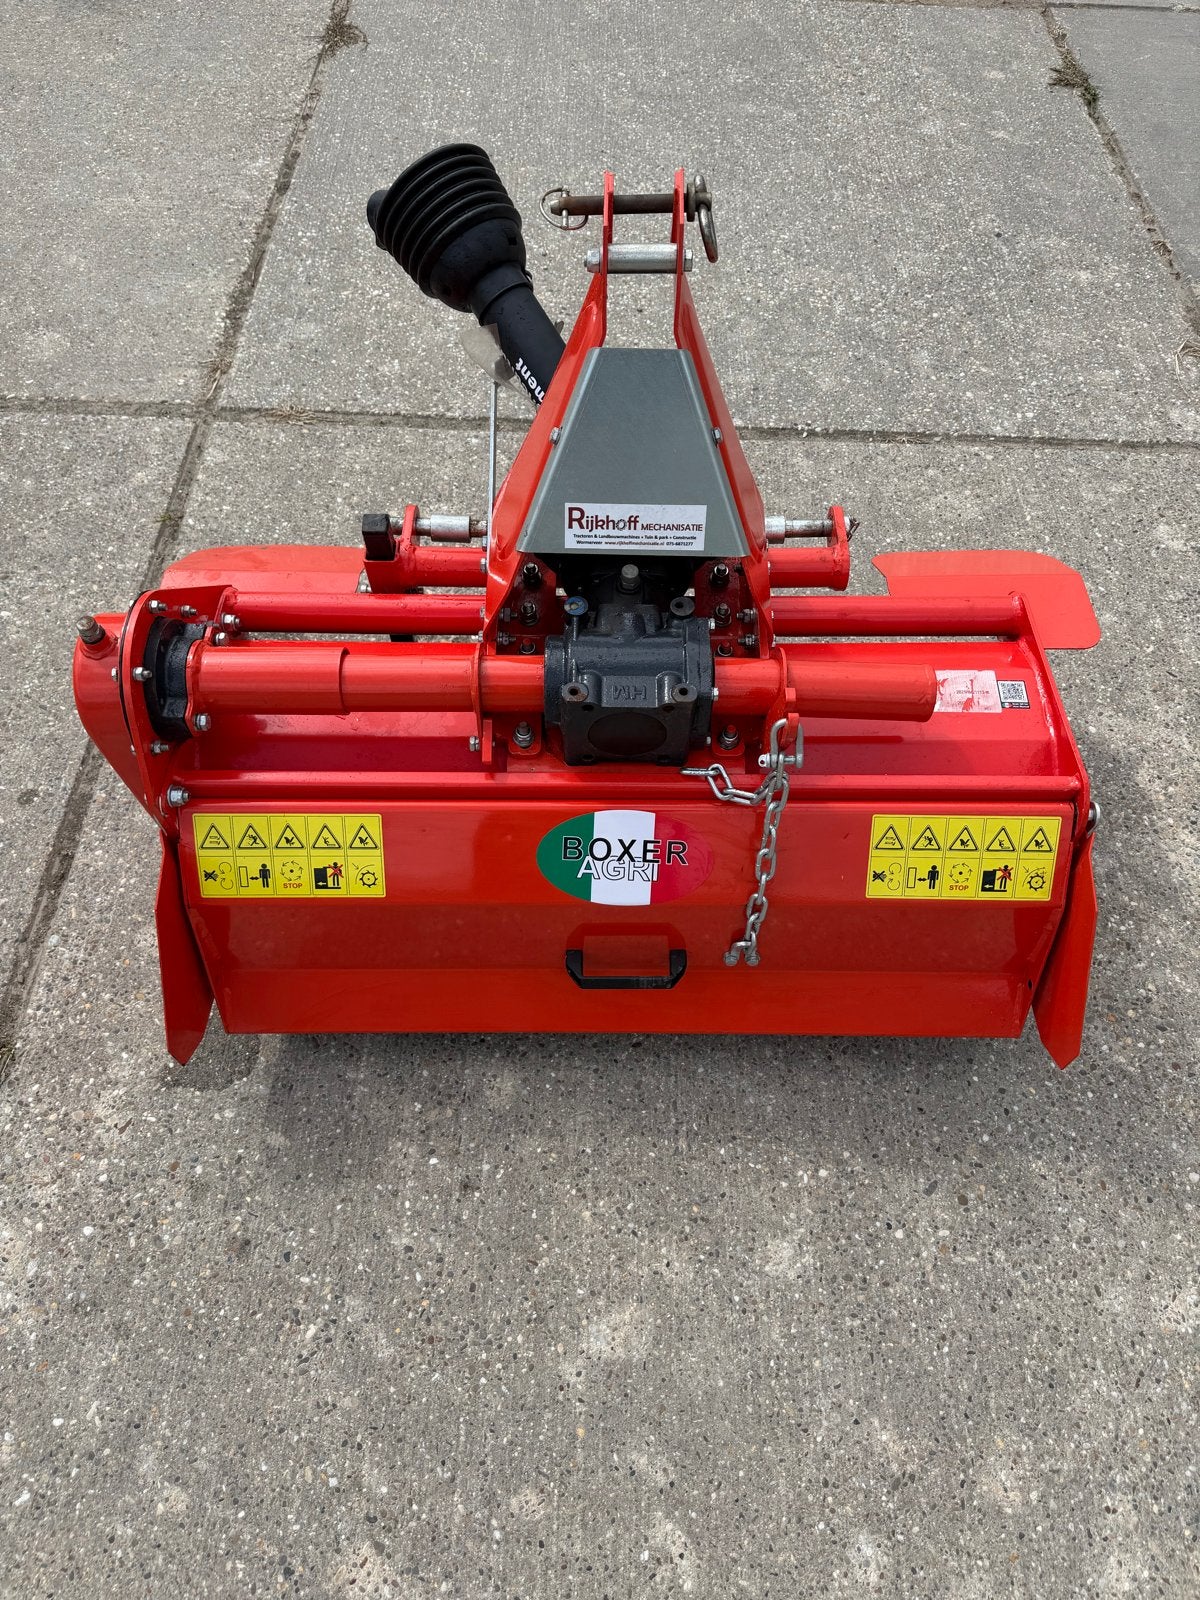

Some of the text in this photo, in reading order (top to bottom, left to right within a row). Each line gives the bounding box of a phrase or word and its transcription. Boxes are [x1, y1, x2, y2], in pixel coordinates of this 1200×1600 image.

[567, 506, 704, 532] Rijkhoff MECHANISATIE
[562, 835, 689, 866] BOXER
[577, 855, 659, 883] AGRI
[282, 882, 304, 890] STOP
[948, 884, 970, 892] STOP
